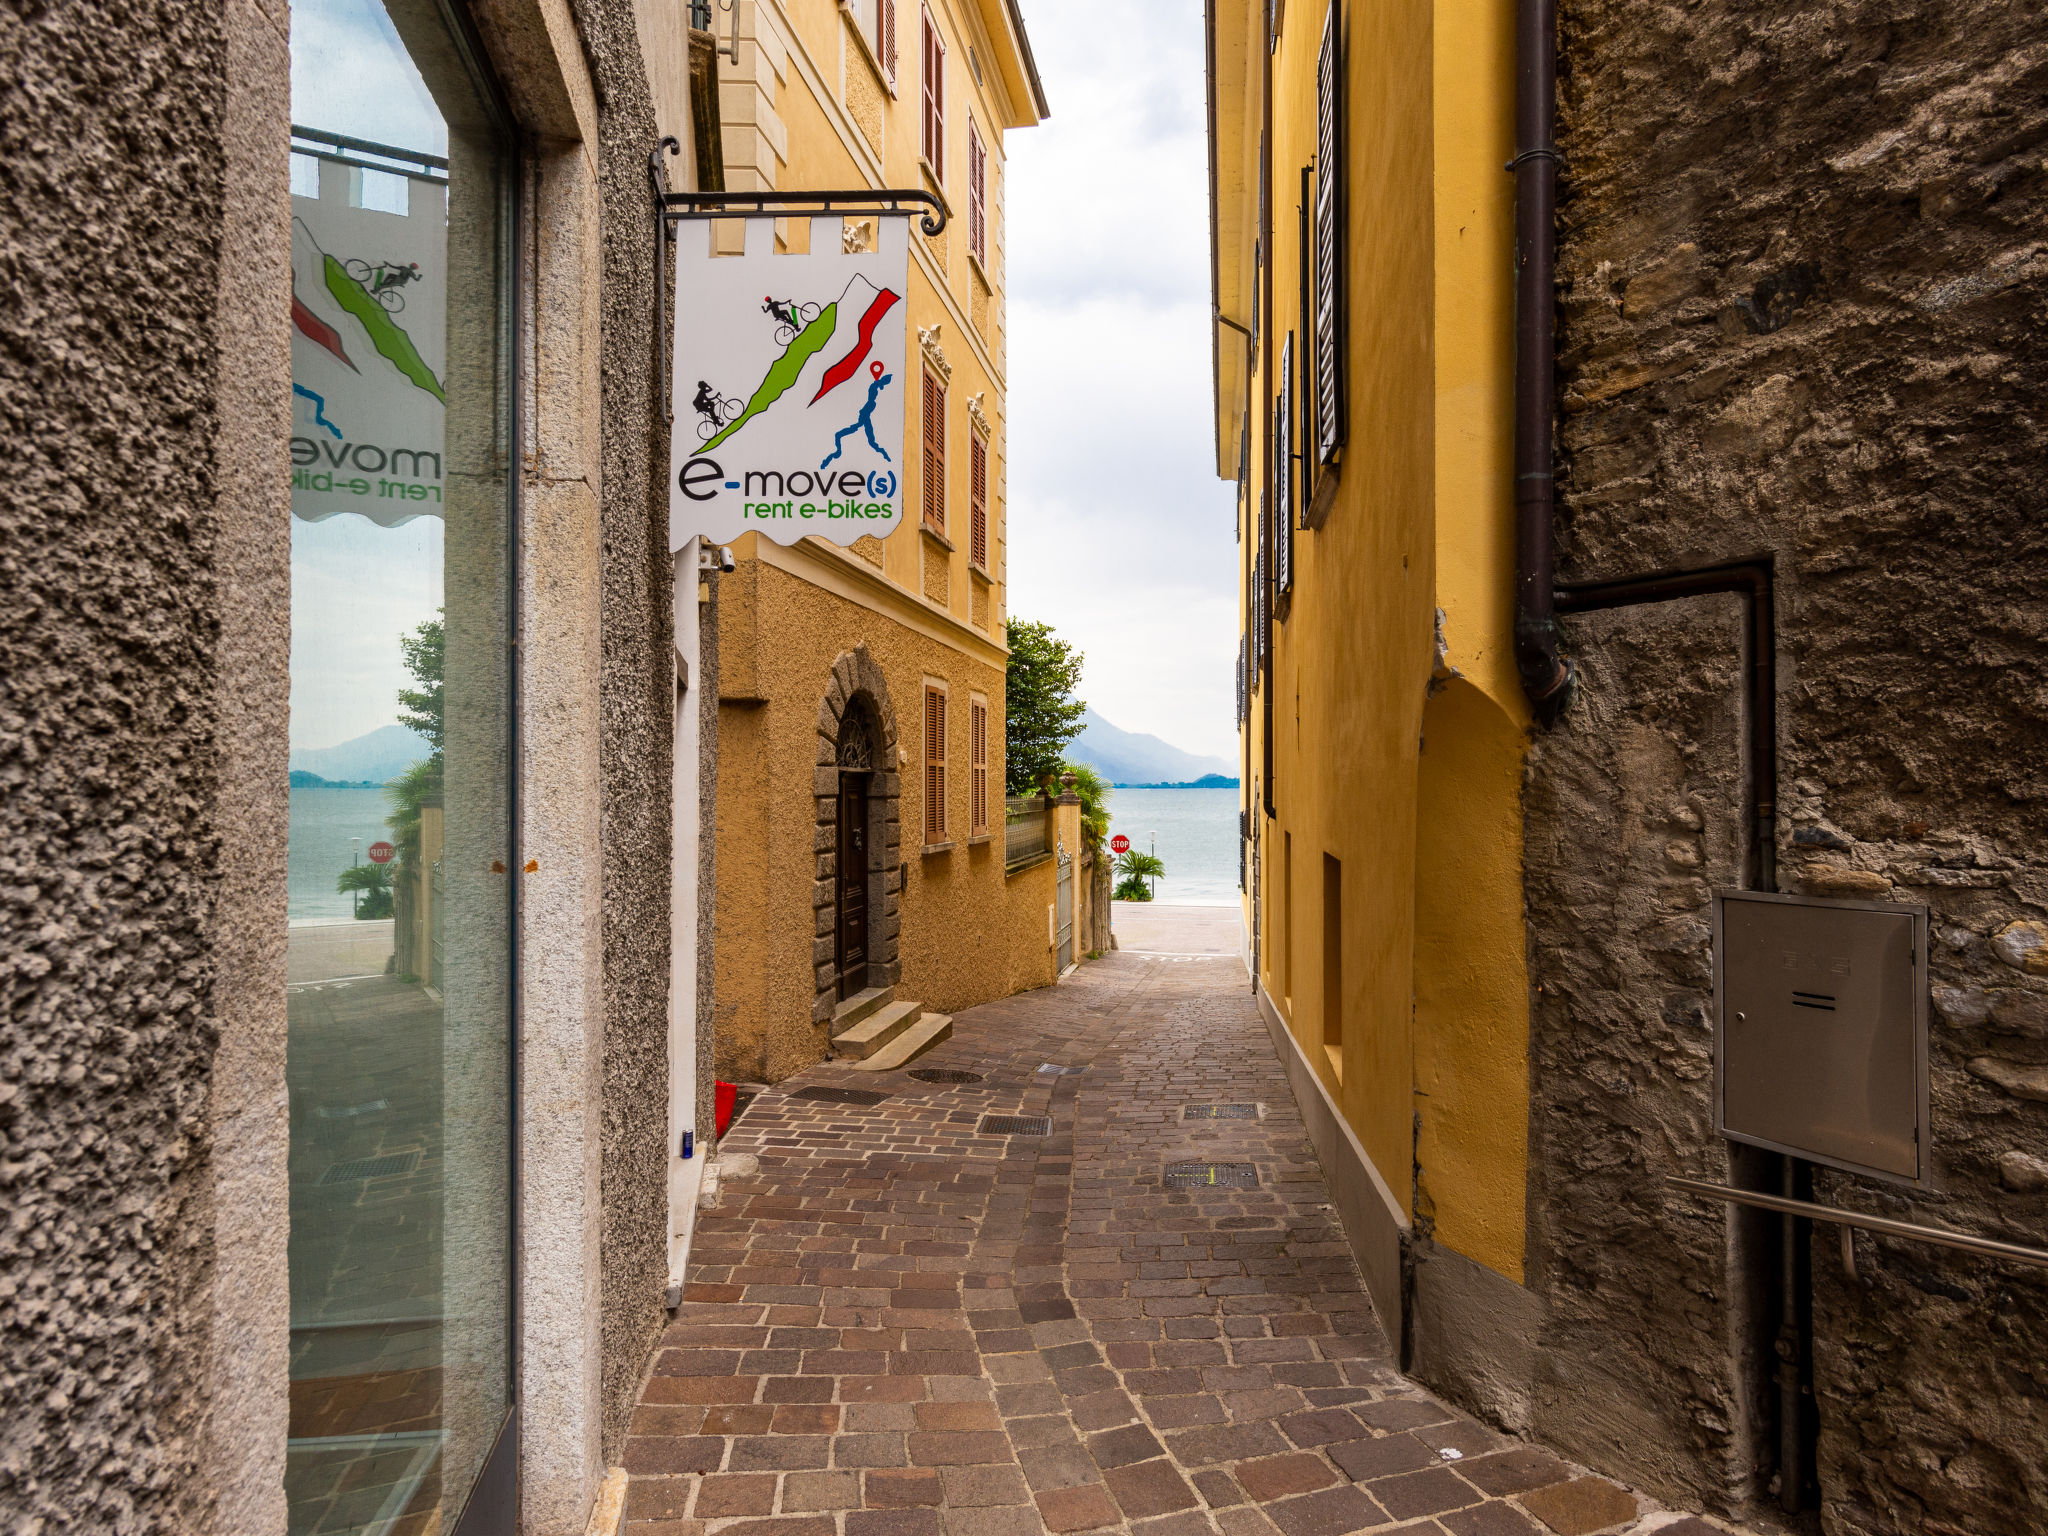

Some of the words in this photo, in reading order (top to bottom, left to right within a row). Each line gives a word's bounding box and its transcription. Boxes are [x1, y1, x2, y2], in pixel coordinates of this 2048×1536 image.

[678, 457, 897, 501] e-move(s)
[744, 500, 794, 519] rent
[799, 499, 893, 519] e-bikes
[1111, 840, 1129, 848] STOP
